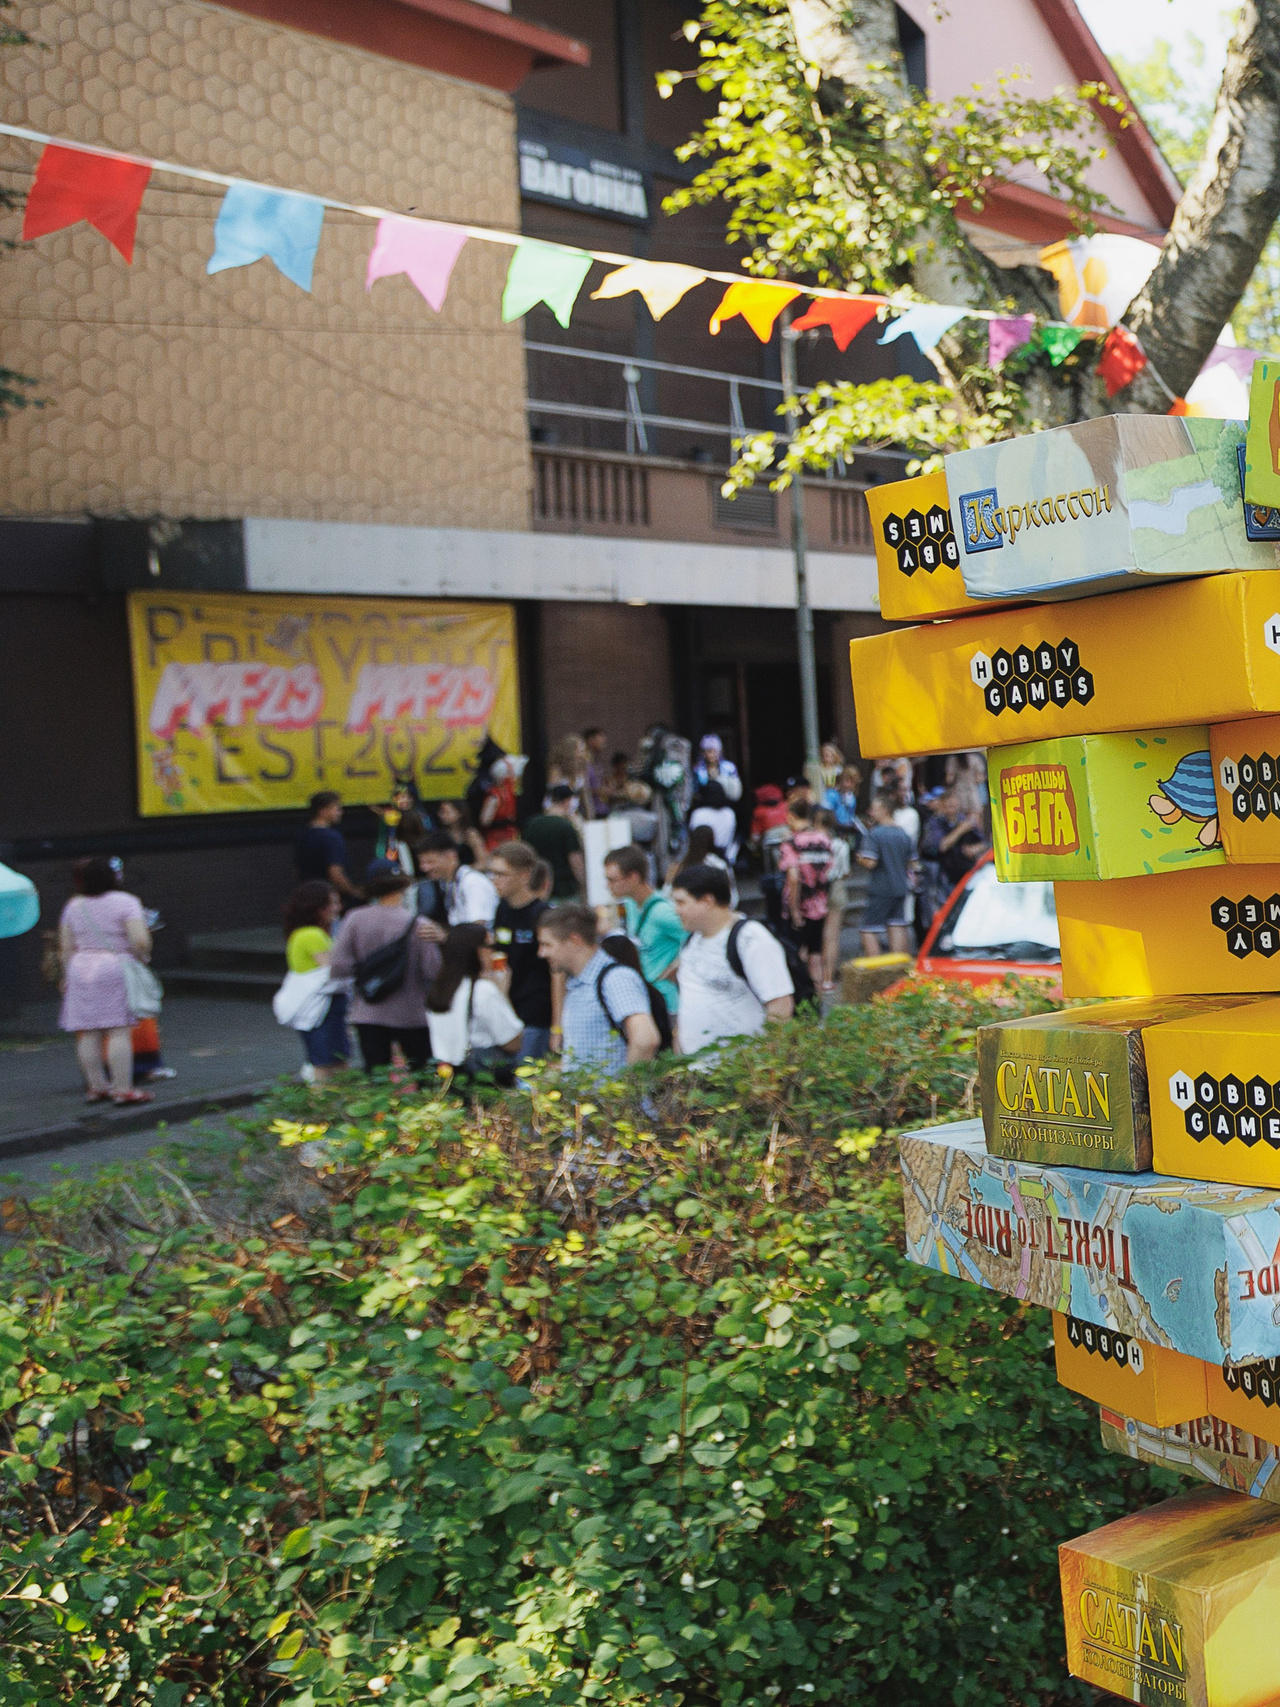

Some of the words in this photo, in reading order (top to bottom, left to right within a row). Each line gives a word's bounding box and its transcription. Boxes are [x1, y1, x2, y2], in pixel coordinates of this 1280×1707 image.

[888, 514, 945, 541] MES
[903, 541, 957, 568] BBY
[975, 646, 1074, 681] HOBBY
[988, 675, 1089, 707] GAMES
[1002, 766, 1067, 796] ЧЕРЕПАШЬИ
[1005, 790, 1076, 848] БЕГА
[996, 1059, 1110, 1122] CATAN
[1000, 1122, 1114, 1151] КОЛОНИЗАТОРЫ
[958, 1193, 1013, 1260] RIDE
[1017, 1217, 1040, 1250] TO
[1044, 1215, 1138, 1294] TICKET
[1071, 1322, 1141, 1366] HOBBY
[1080, 1588, 1183, 1673] CATAN
[1082, 1646, 1187, 1702] КОЛОНИЗАТОРЫ
